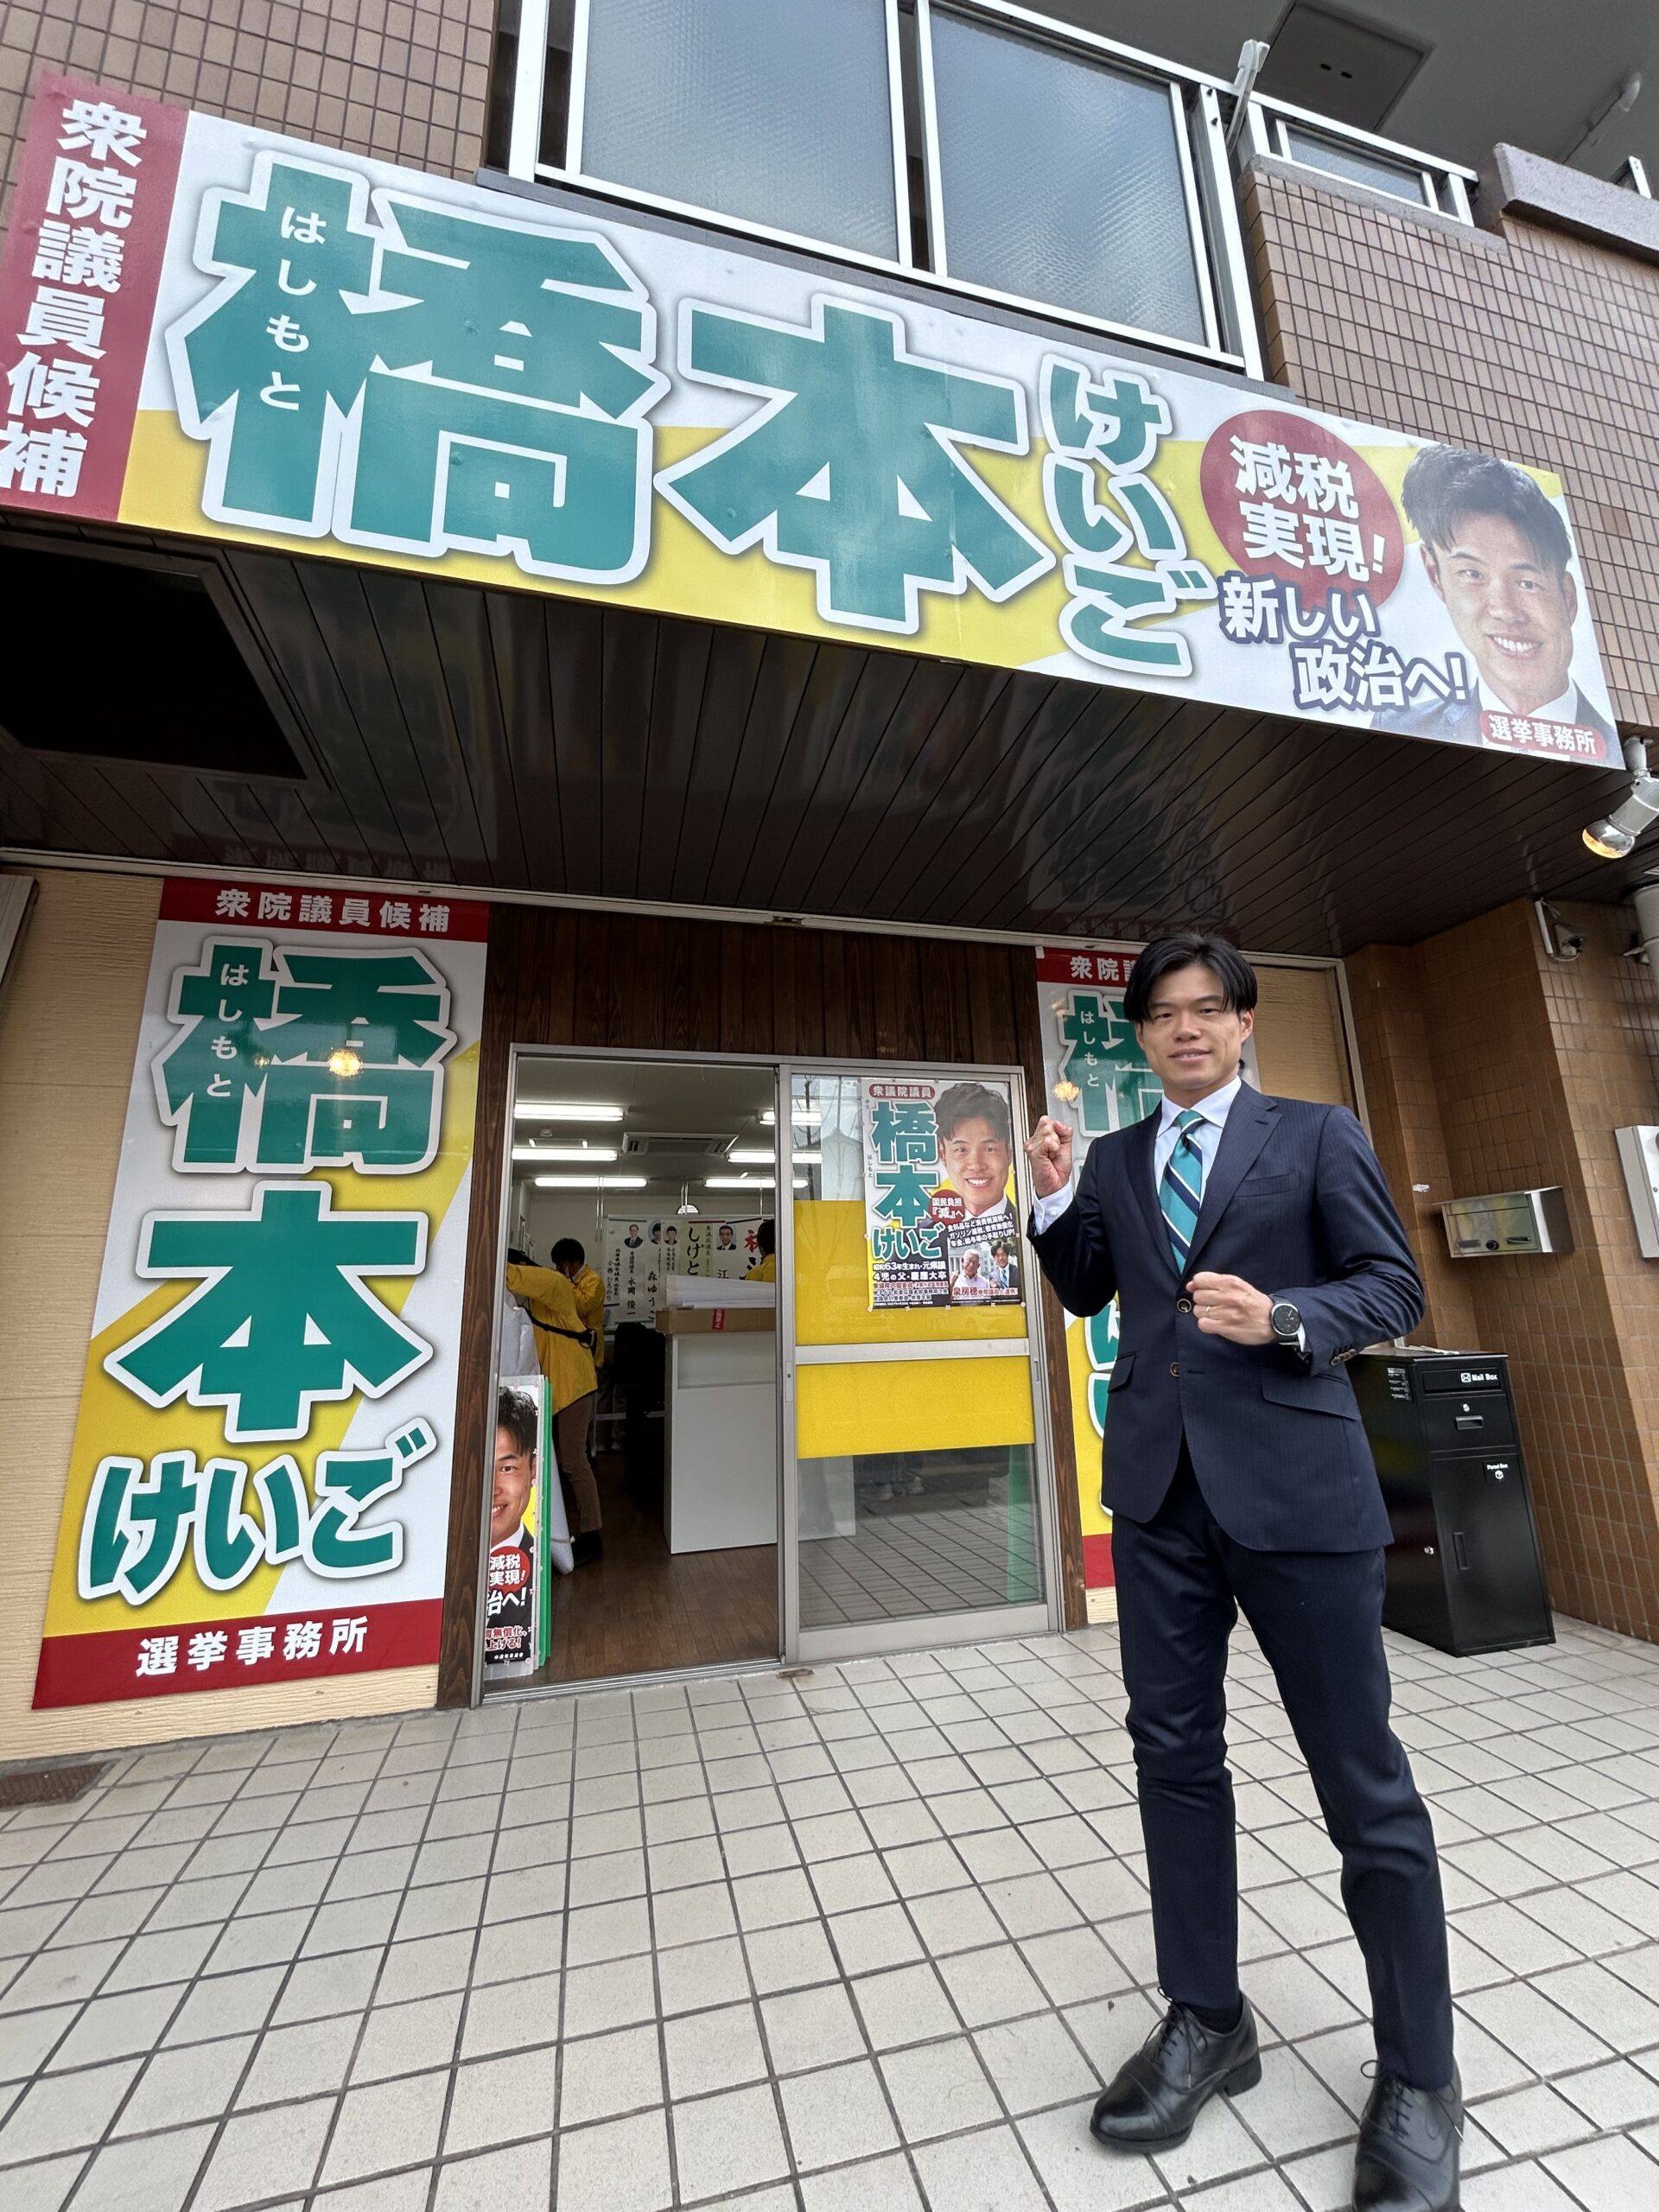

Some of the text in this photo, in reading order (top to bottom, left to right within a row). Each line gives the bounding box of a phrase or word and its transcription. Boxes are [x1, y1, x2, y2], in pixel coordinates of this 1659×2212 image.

[0, 99, 148, 499] 衆院議員候補
[259, 207, 327, 412] はしもと
[175, 158, 1049, 627] 橋本
[1044, 358, 1213, 671] けいご
[1229, 434, 1360, 518] 減税
[1238, 501, 1387, 583] 実現!
[1219, 574, 1379, 641] 新しい
[1294, 644, 1467, 709] 政治へ!
[1487, 713, 1599, 756] 選挙事務所
[214, 887, 451, 933] 衆院議員候補
[205, 963, 249, 1098] はしもと
[1080, 1009, 1100, 1089] はしもと
[873, 1085, 932, 1098] 衆議院議員
[111, 940, 453, 1436] 橋本
[869, 1100, 941, 1228] 橋本
[932, 1198, 963, 1206] 国民負担
[873, 1223, 946, 1262] けいご
[84, 1421, 432, 1599] けいご
[489, 1569, 526, 1586] 実現!
[490, 1554, 521, 1571] 減税
[135, 1614, 370, 1679] 選挙事務所
